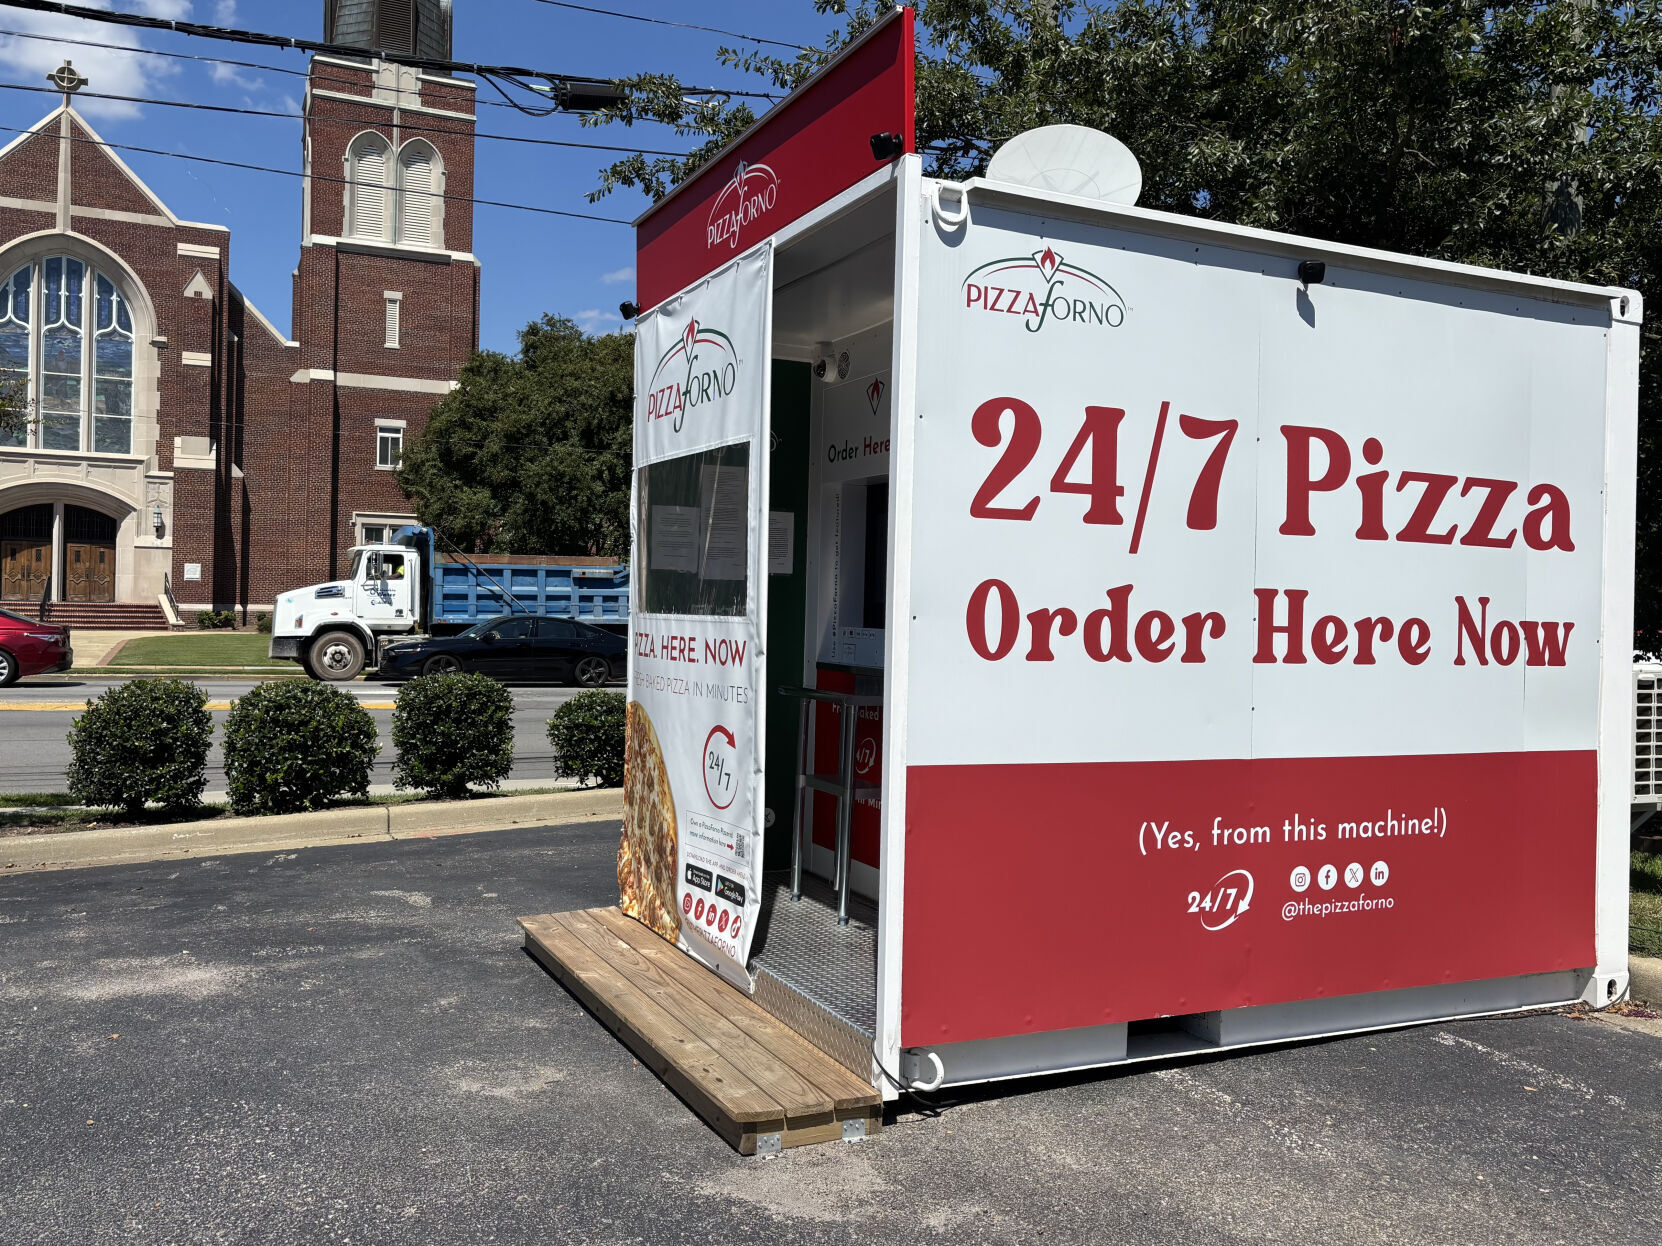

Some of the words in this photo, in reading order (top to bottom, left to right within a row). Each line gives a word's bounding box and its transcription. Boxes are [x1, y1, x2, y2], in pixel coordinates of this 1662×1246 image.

[828, 440, 859, 463] Order
[863, 435, 890, 456] Here
[969, 396, 1239, 554] 24/7
[1278, 424, 1576, 553] Pizza
[965, 578, 1227, 663] Order
[1252, 588, 1431, 666] Here
[1453, 595, 1575, 667] Now
[661, 634, 699, 664] HERE.
[704, 638, 747, 668] NOW
[645, 674, 665, 692] BAKED
[667, 677, 690, 695] PIZZA
[693, 680, 703, 697] IN
[706, 683, 749, 704] MINUTES
[708, 750, 731, 792] 24/7
[1138, 821, 1201, 856] (Yes,
[1212, 816, 1271, 846] from
[1283, 813, 1327, 842] this
[1337, 807, 1448, 839] machine!)
[692, 874, 701, 885] App
[700, 876, 711, 888] Store
[1186, 888, 1238, 914] 24/7
[1281, 894, 1395, 922] @thepizzaforno
